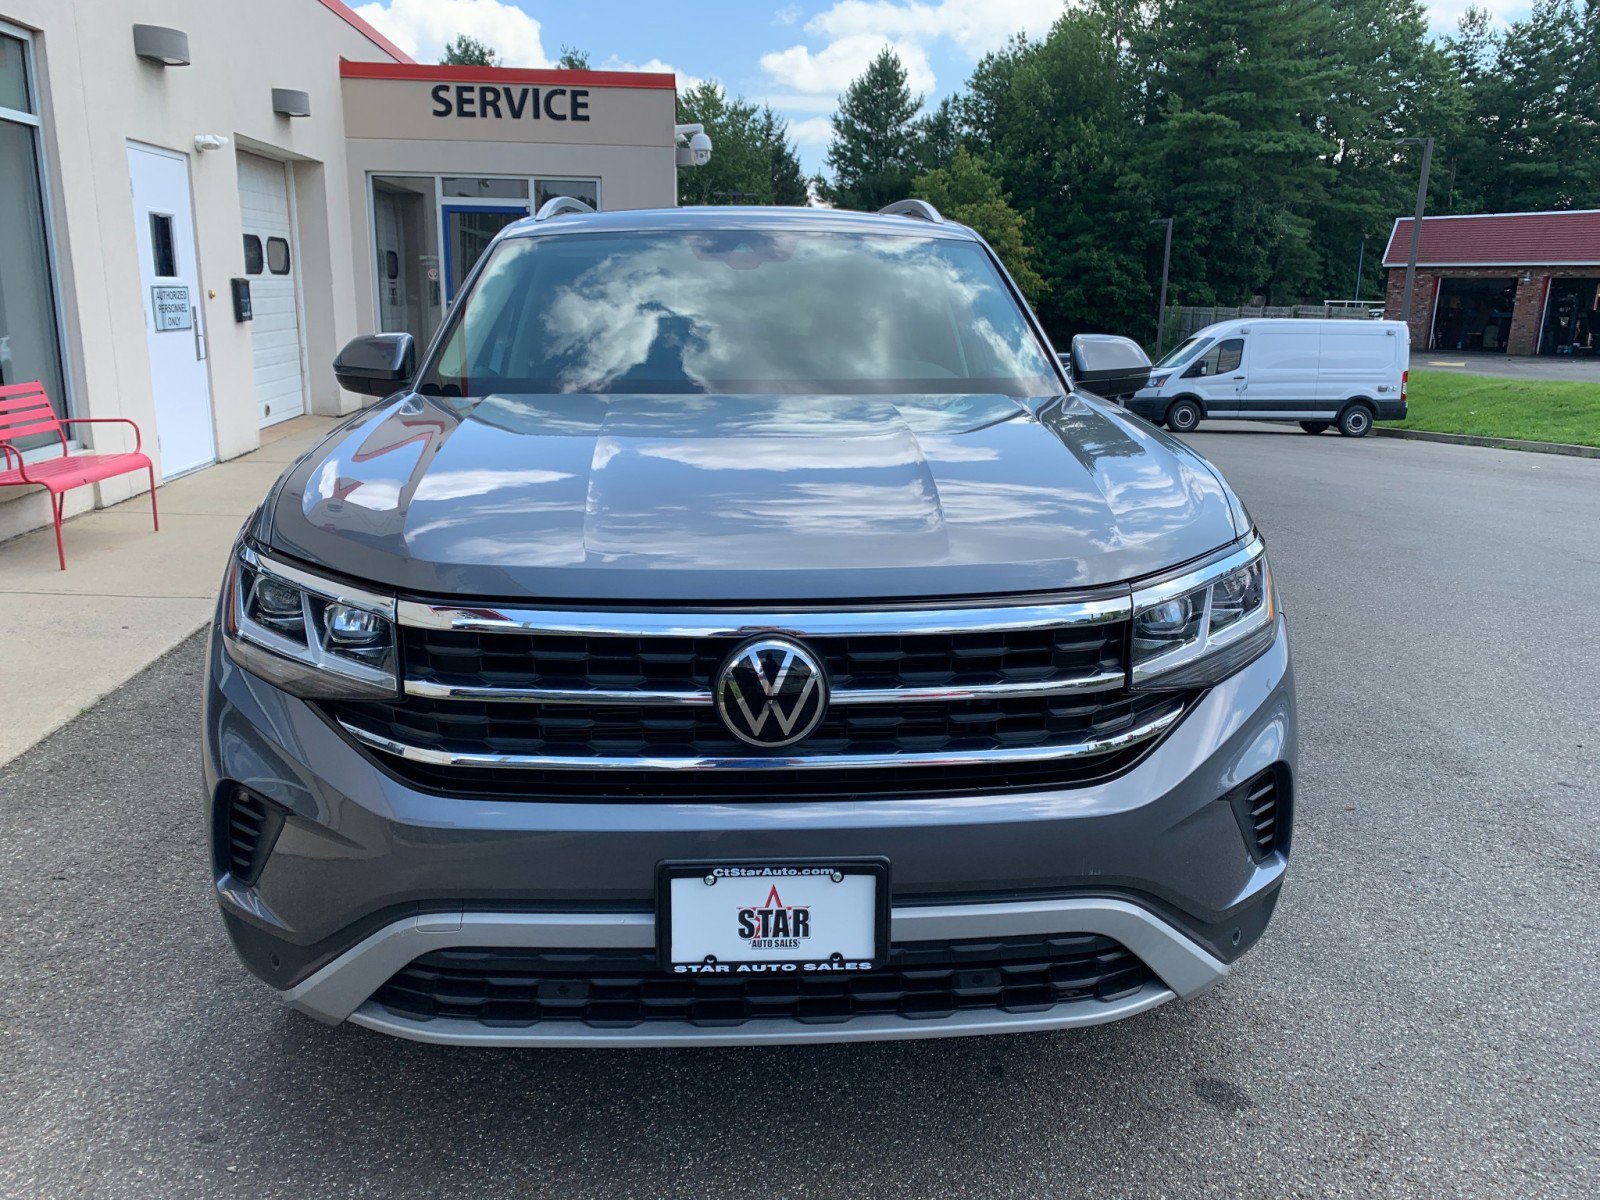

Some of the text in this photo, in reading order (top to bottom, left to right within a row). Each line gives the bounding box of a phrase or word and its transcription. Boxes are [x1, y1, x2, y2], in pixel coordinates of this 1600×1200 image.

[431, 84, 590, 121] SERVICE
[156, 290, 187, 300] AUTHORIZED
[158, 303, 188, 313] PERSONNEL
[167, 316, 181, 326] ONLY
[712, 867, 834, 877] CtStarAuto.com
[737, 908, 810, 939] STAR
[751, 938, 798, 948] AUTO SALES
[674, 962, 872, 973] STAR AUTO SALES
